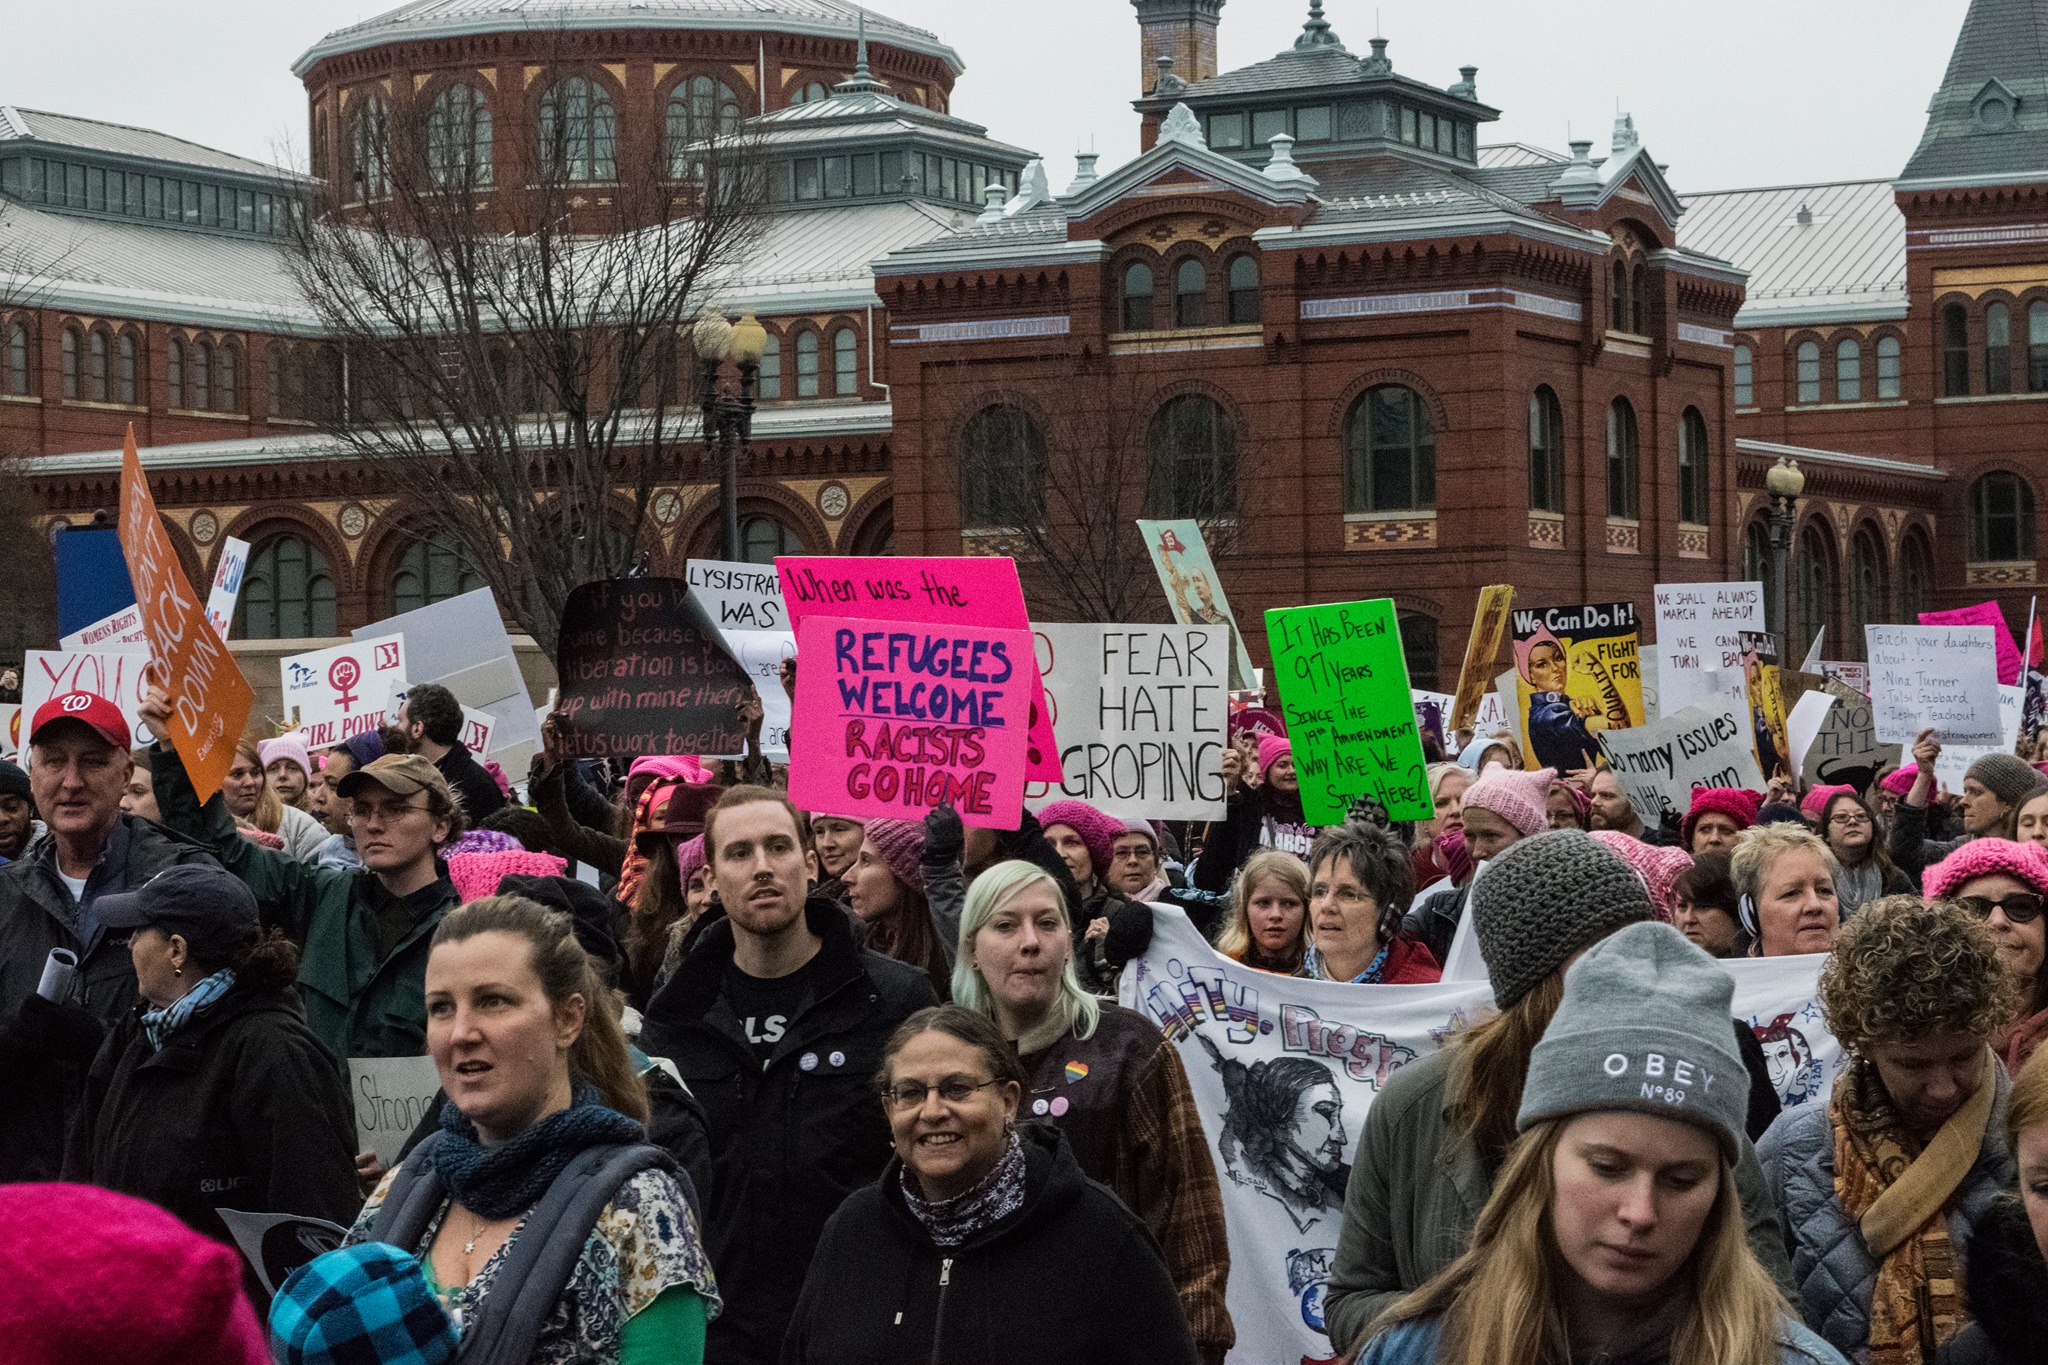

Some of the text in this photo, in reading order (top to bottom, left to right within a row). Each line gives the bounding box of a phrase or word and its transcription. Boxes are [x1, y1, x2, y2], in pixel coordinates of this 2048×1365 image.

[785, 568, 968, 607] When was the
[1657, 590, 1758, 606] WE SHALL ALWAYS
[620, 592, 663, 622] you
[721, 600, 780, 628] WAS
[1513, 602, 1636, 634] We Can Do It!
[1663, 605, 1754, 621] MARCH AHEAD!
[111, 611, 137, 634] RIGHTS
[149, 566, 191, 688] BACK
[617, 621, 694, 647] because
[1272, 609, 1386, 654] IT HAS BEEN
[835, 628, 1012, 684] REFUGEES
[1102, 630, 1214, 677] FEAR
[1597, 639, 1637, 662] FIGHT
[1677, 636, 1697, 649] WE
[1868, 626, 1993, 656] Teach your daughters
[681, 655, 698, 675] is
[1294, 652, 1373, 696] 97 YEARS
[1611, 660, 1640, 681] FOR
[1671, 654, 1699, 669] TURN
[39, 653, 123, 709] YOU
[176, 624, 219, 737] DOWN
[1915, 670, 1960, 688] Turner
[61, 695, 92, 712] W
[590, 682, 632, 713] with
[635, 684, 691, 710] mine
[837, 676, 1005, 726] WELCOME
[1099, 684, 1221, 733] HATE
[1918, 688, 1968, 704] Gabbard
[1286, 703, 1334, 727] SINCE
[1335, 697, 1370, 721] THE
[1926, 705, 1977, 721] Teachout
[845, 718, 985, 769] RACISTS
[1304, 726, 1327, 746] 19th
[1598, 731, 1626, 773] So
[1626, 742, 1673, 781] many
[1677, 712, 1737, 760] issues
[1817, 727, 1893, 755] THI
[1059, 740, 1226, 803] GROPING
[1297, 744, 1400, 781] WHY ARE WE
[1373, 764, 1427, 809] HERE?
[1603, 1053, 1715, 1094] OBEY
